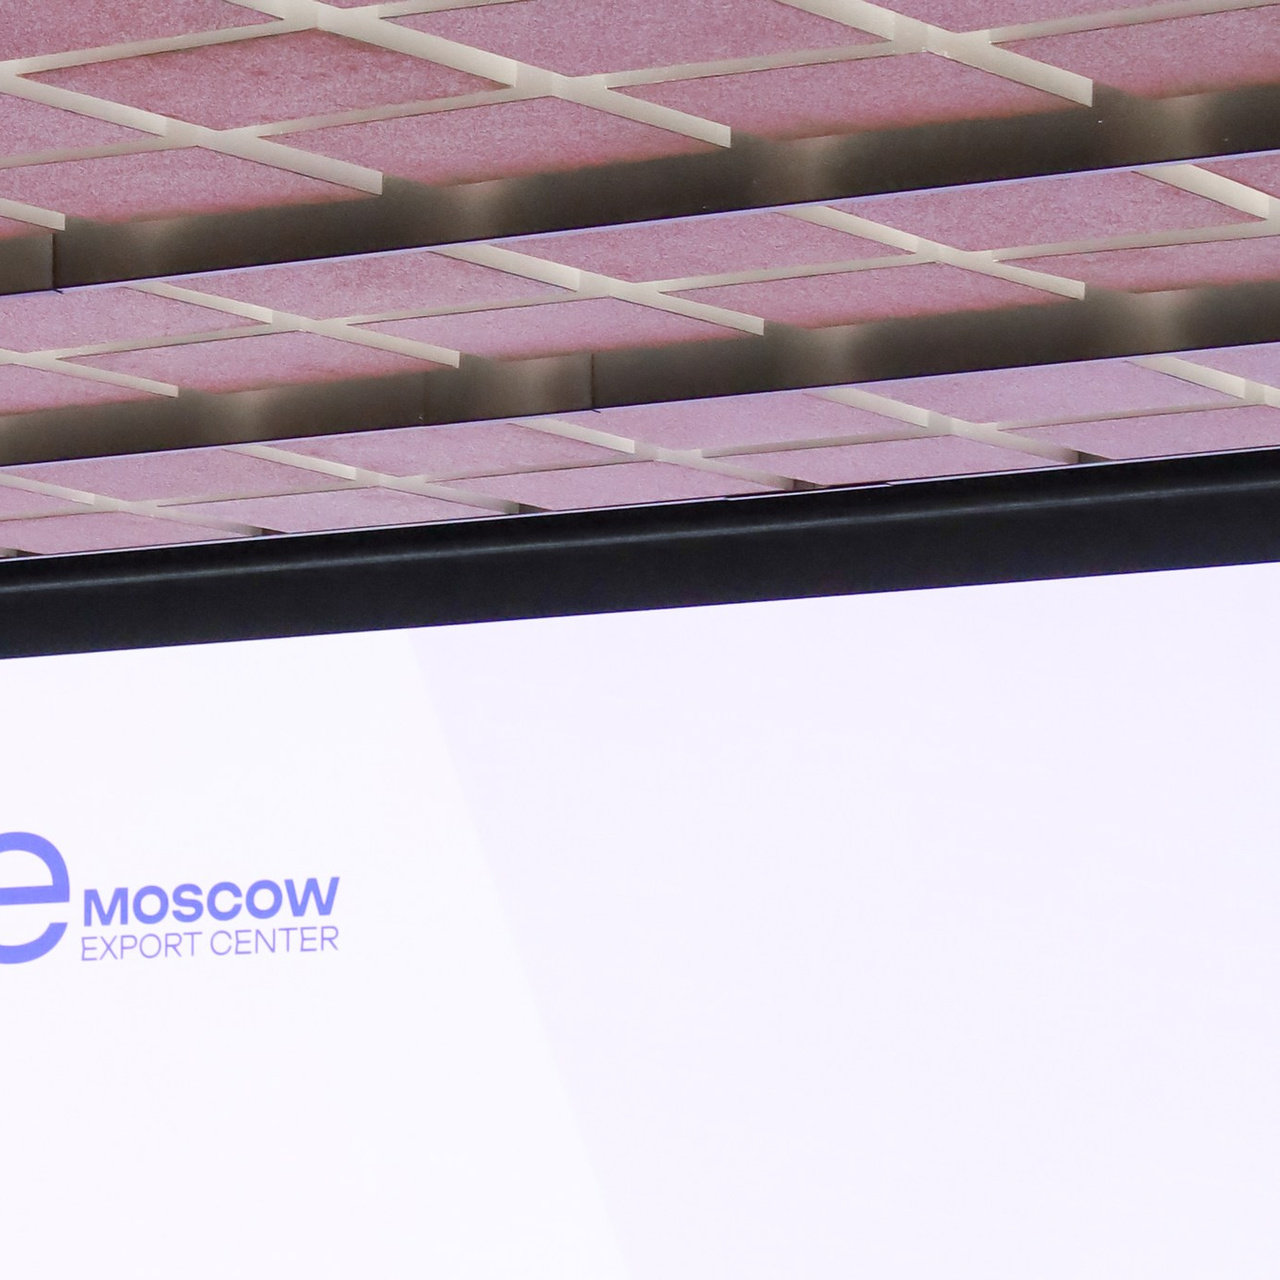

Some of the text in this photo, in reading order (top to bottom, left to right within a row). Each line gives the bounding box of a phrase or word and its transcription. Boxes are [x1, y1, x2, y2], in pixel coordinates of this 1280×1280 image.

[83, 876, 340, 928] MOSCOW
[81, 925, 339, 963] EXPORT CENTER
